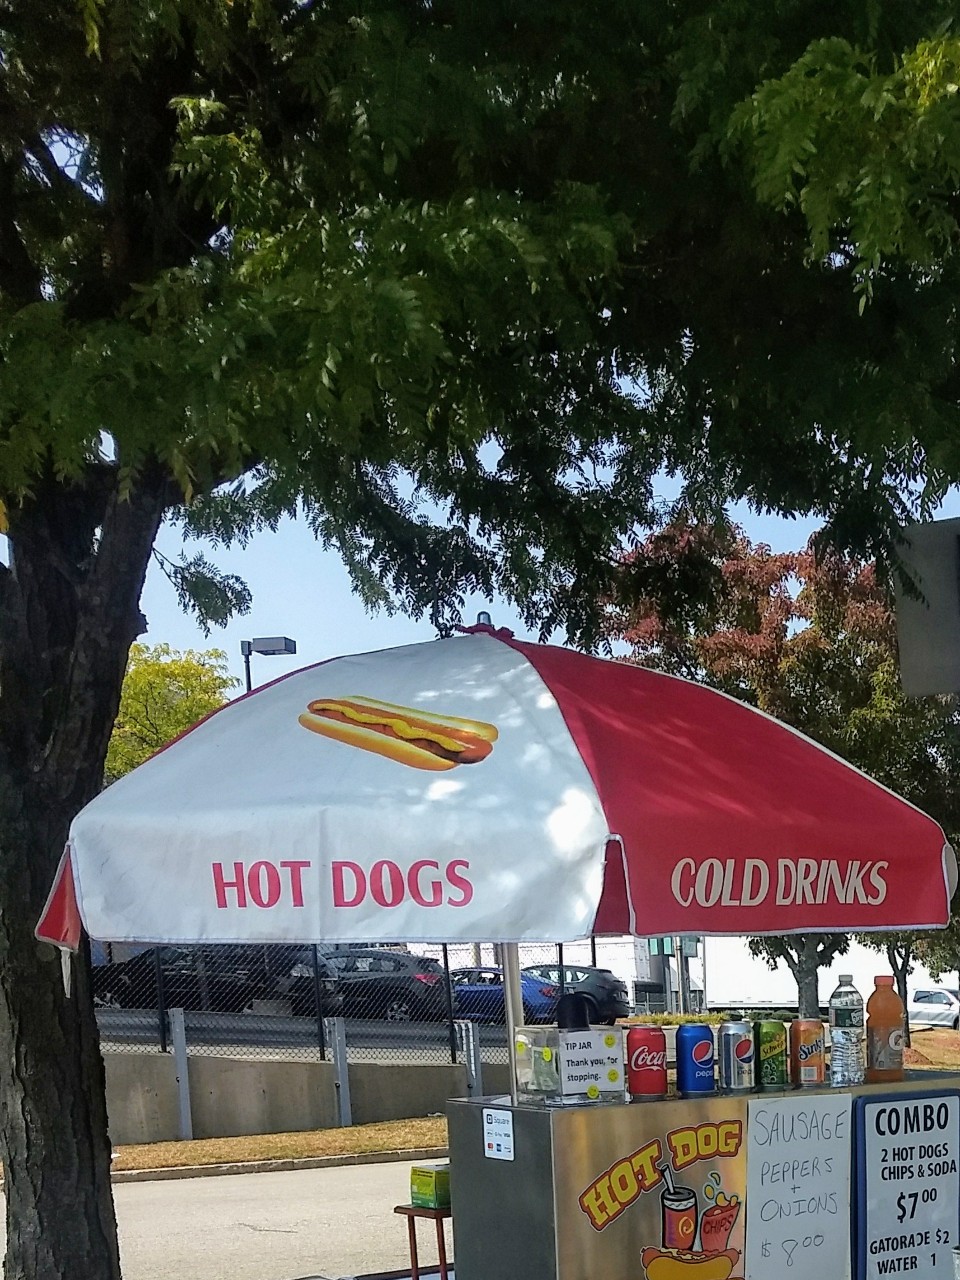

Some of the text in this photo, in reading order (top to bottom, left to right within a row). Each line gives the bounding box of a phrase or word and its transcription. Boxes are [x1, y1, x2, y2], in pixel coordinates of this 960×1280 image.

[212, 859, 474, 909] HOT DOGS
[671, 857, 889, 908] COLD DRINKS
[565, 1041, 592, 1050] TIP JAR
[799, 1039, 823, 1060] Sunk
[566, 1058, 589, 1068] Thank
[590, 1058, 606, 1068] you,
[567, 1071, 602, 1082] stopping.
[695, 1070, 713, 1078] peps
[754, 1109, 847, 1146] SAUSAGE
[875, 1103, 949, 1136] COMBO
[881, 1143, 949, 1162] 2 HOT DOGS
[581, 1122, 740, 1229] HOT DOG
[761, 1156, 833, 1186] PEPPERS
[881, 1160, 957, 1180] CHIPS & SODA
[760, 1192, 838, 1221] ONIONS
[703, 1215, 733, 1234] CHIPS
[870, 1228, 949, 1255] GATORADE $2
[878, 1253, 936, 1274] WATER 1
